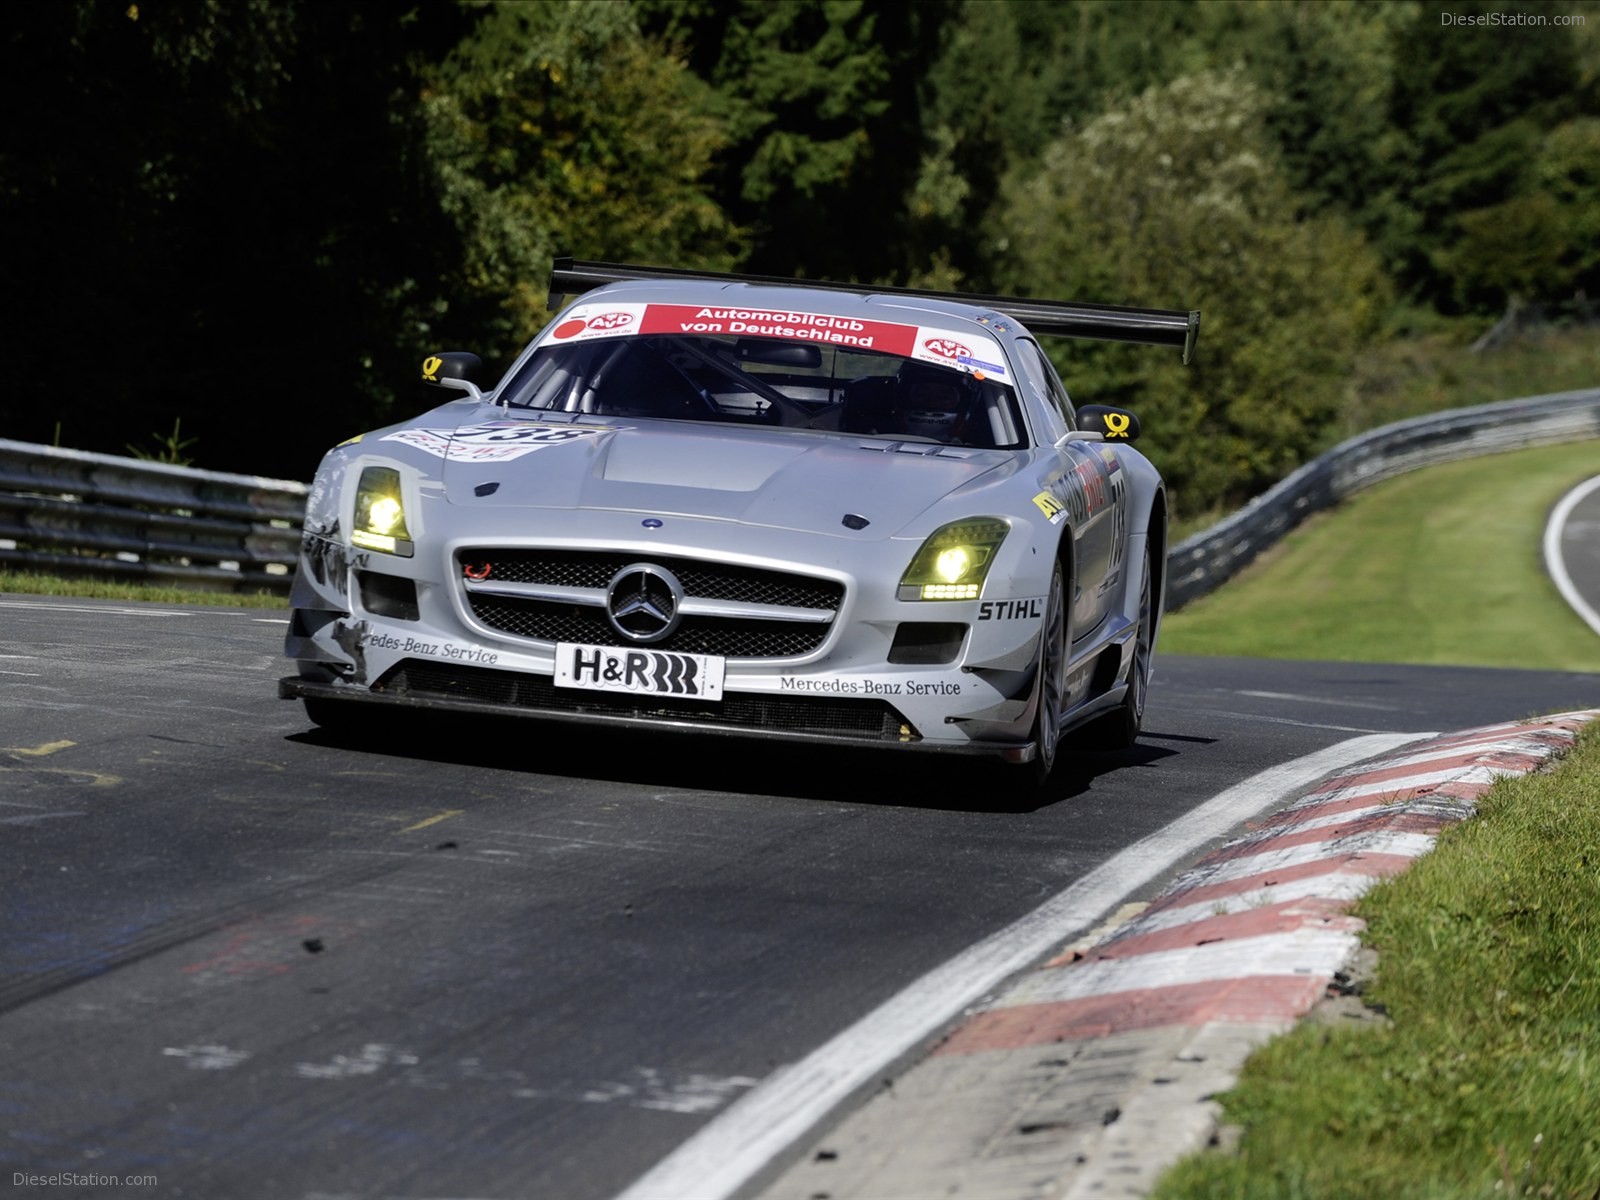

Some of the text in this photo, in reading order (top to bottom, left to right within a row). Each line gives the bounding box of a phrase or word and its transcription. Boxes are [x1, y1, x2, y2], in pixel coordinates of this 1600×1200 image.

[588, 313, 633, 329] AvD
[695, 308, 864, 331] Automobilclub
[680, 321, 874, 347] von Deutschland
[927, 340, 971, 358] AvD
[452, 427, 597, 441] 738
[978, 602, 1041, 620] STIHL
[441, 643, 498, 665] Service
[574, 648, 649, 687] H&R
[780, 677, 961, 695] Mercedes-Benz Service
